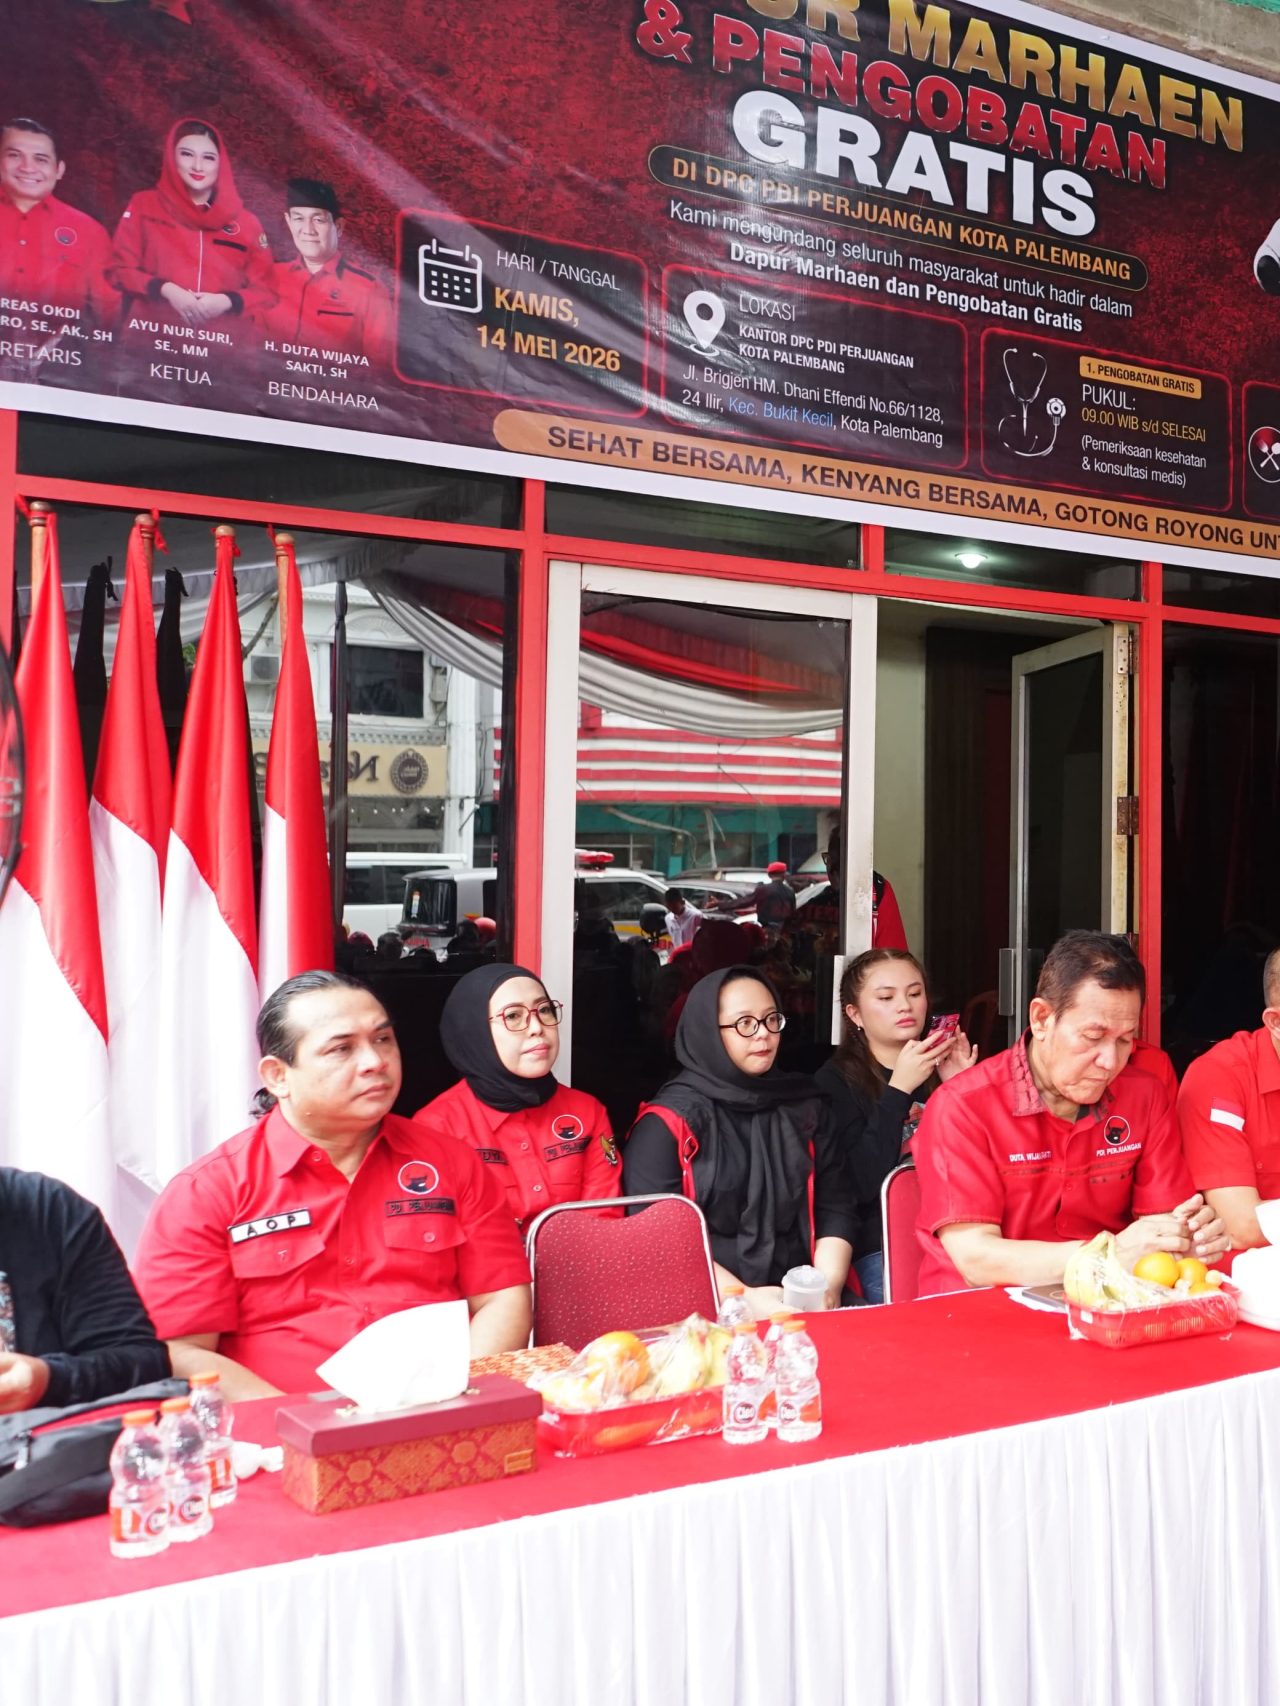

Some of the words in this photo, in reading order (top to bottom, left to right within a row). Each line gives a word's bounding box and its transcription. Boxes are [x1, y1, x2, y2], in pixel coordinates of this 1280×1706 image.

[888, 0, 1243, 152] MARHAEN
[636, 0, 693, 64] &
[713, 13, 1166, 190] PENGOBATAN
[732, 90, 1096, 236] GRATIS
[672, 157, 697, 182] DI
[706, 165, 755, 193] DPC
[761, 179, 800, 205] PDI
[808, 189, 952, 240] PERJUANGAN
[959, 225, 1009, 253] KOTA
[1015, 238, 1131, 281] PALEMBANG
[497, 250, 535, 273] HARI
[550, 260, 621, 291] TANGGAL
[670, 200, 716, 228] Kami
[723, 215, 836, 257] mengundang
[842, 242, 903, 268] seluruh
[909, 255, 999, 289] masyarakat
[1003, 276, 1045, 299] untuk
[1050, 284, 1086, 307] hadir
[1089, 294, 1133, 318] dalam
[730, 242, 791, 272] Dapur
[796, 256, 879, 290] Marhaen
[886, 276, 920, 299] dan
[925, 283, 1028, 322] Pengobatan
[1034, 306, 1083, 333] Gratis
[42, 305, 80, 319] OKDI
[494, 287, 579, 328] KAMIS,
[738, 294, 796, 322] LOKASI
[31, 320, 56, 335] SE.,
[60, 325, 89, 340] AK.,
[93, 330, 113, 342] SH
[129, 318, 159, 333] AYU
[163, 323, 194, 339] NUR
[198, 329, 233, 346] SURI,
[154, 339, 178, 354] SE.,
[183, 344, 208, 357] MM
[477, 325, 506, 350] 14
[514, 332, 557, 360] MEI
[564, 342, 621, 372] 2026
[739, 324, 787, 345] KANTOR
[790, 335, 814, 350] DPC
[817, 339, 836, 354] PDI
[840, 344, 914, 369] PERJUANGAN
[265, 340, 278, 352] H.
[282, 343, 319, 358] DUTA
[321, 350, 370, 367] WIJAYA
[739, 343, 770, 361] KOTA
[773, 349, 845, 374] PALEMBANG
[150, 363, 212, 386] KETUA
[330, 367, 347, 379] SH
[683, 364, 698, 382] Jl.
[703, 368, 750, 391] Brigjen
[753, 377, 780, 394] HM.
[784, 381, 820, 402] Dhani
[824, 388, 866, 410] Effendi
[1086, 362, 1096, 374] 1.
[1097, 364, 1160, 386] PENGOBATAN
[1162, 377, 1195, 394] GRATIS
[268, 381, 379, 410] BENDAHARA
[1082, 384, 1136, 411] PUKUL:
[682, 389, 700, 407] 24
[728, 396, 757, 416] Kec.
[763, 402, 798, 422] Bukit
[802, 408, 836, 431] Kecil,
[841, 414, 870, 433] Kota
[873, 420, 943, 448] Palembang
[1081, 407, 1115, 427] 09.00
[1117, 413, 1138, 431] WIB
[1141, 417, 1159, 435] s/d
[1162, 421, 1206, 443] SELESAI
[1081, 434, 1152, 460] (Pemeriksaan
[1155, 444, 1207, 468] kesehatan
[547, 426, 643, 460] SEHAT
[652, 442, 793, 485] BERSAMA,
[801, 464, 921, 501] KENYANG
[928, 483, 1048, 522] BERSAMA,
[1055, 502, 1149, 533] GOTONG
[1155, 517, 1244, 547] ROYONG
[1082, 456, 1091, 471] &
[1094, 459, 1148, 481] konsultasi
[1151, 468, 1186, 489] medis)
